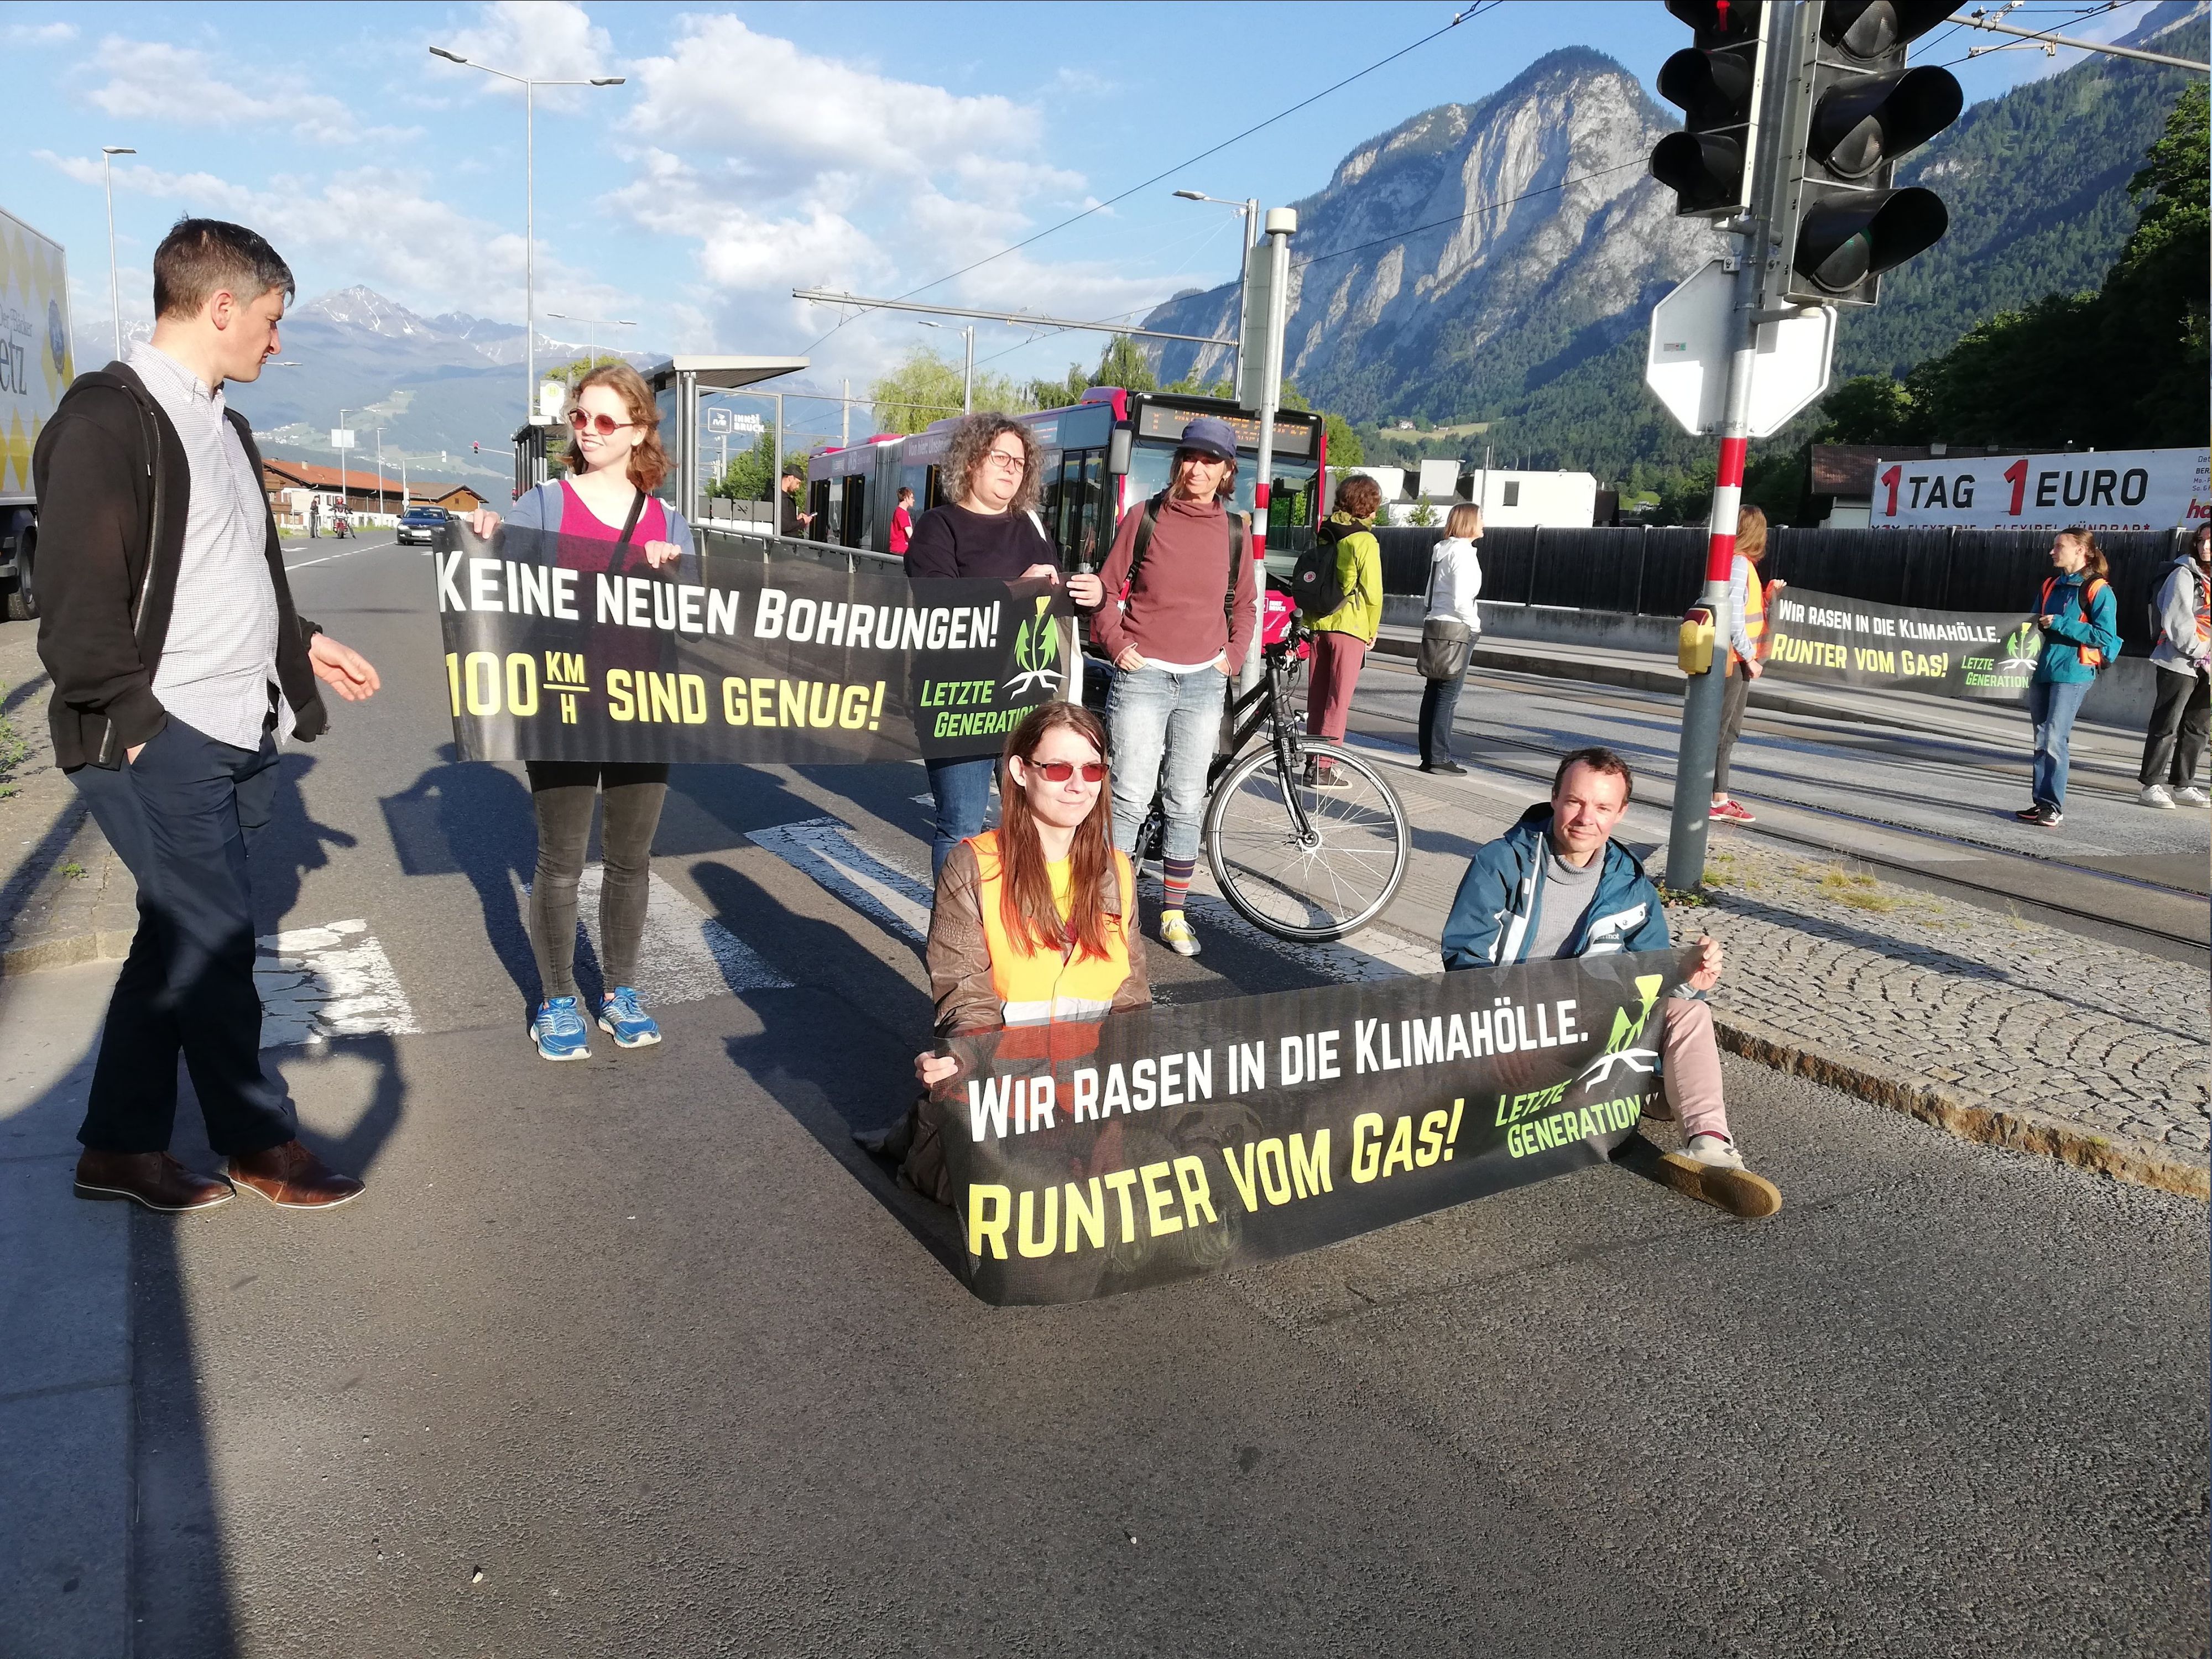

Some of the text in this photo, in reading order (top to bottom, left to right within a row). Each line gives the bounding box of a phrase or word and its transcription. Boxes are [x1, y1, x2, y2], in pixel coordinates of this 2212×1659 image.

[1881, 459, 2148, 517] 1 TAG 1 EURO
[435, 551, 1000, 650] KEINE NEUEN BOHRUNGEN!
[1778, 599, 2001, 643] WIR RASEN IN DIE KLIMAHÖLLE.
[1770, 633, 1949, 678] RUNTER VOM GAS!
[1960, 655, 1995, 671] LETZTE
[445, 651, 538, 717] 100
[606, 668, 707, 724] SIND
[722, 676, 886, 731] GENUG!
[920, 680, 995, 707] LETZTE
[933, 704, 1039, 738] GENERATI
[968, 995, 1589, 1142] WIR RASEN IN DIE KLIMAHÖLLE.
[1495, 1078, 1573, 1127] LETZTE
[1507, 1094, 1641, 1159] GENERATION
[968, 1098, 1465, 1260] RUNTER VOM GAS!
